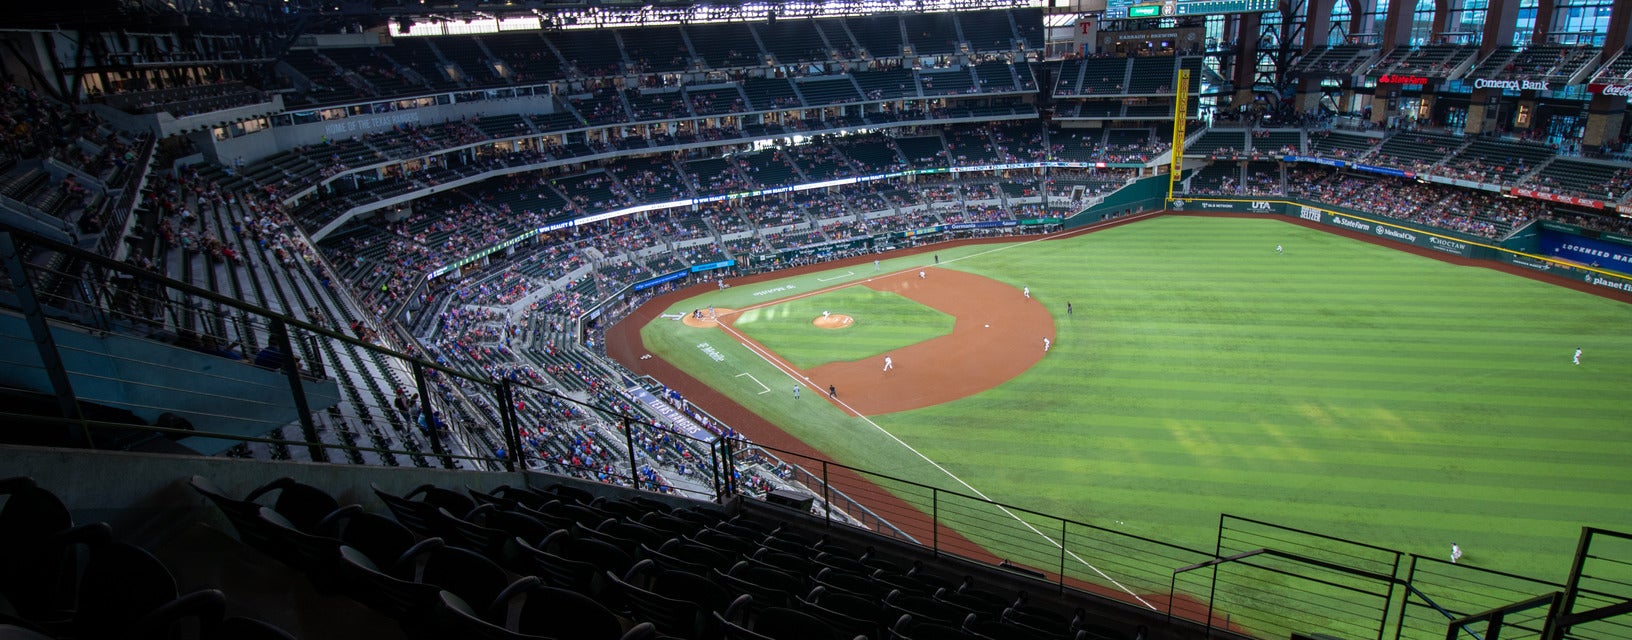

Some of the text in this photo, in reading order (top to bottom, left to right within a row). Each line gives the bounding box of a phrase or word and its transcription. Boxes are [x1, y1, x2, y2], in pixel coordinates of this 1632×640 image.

[1079, 22, 1091, 34] T
[1521, 79, 1550, 90] Bank
[325, 122, 345, 134] HOME
[348, 121, 356, 131] OF
[358, 119, 370, 130] THE
[371, 116, 390, 128] TEXAS
[1252, 201, 1271, 209] UTA
[1300, 210, 1321, 222] SELTZER
[1430, 236, 1466, 249] CHOCTAW
[1562, 243, 1610, 258] LOCKHEED
[1593, 277, 1623, 290] planet
[649, 399, 701, 434] TEXAS RANGERS
